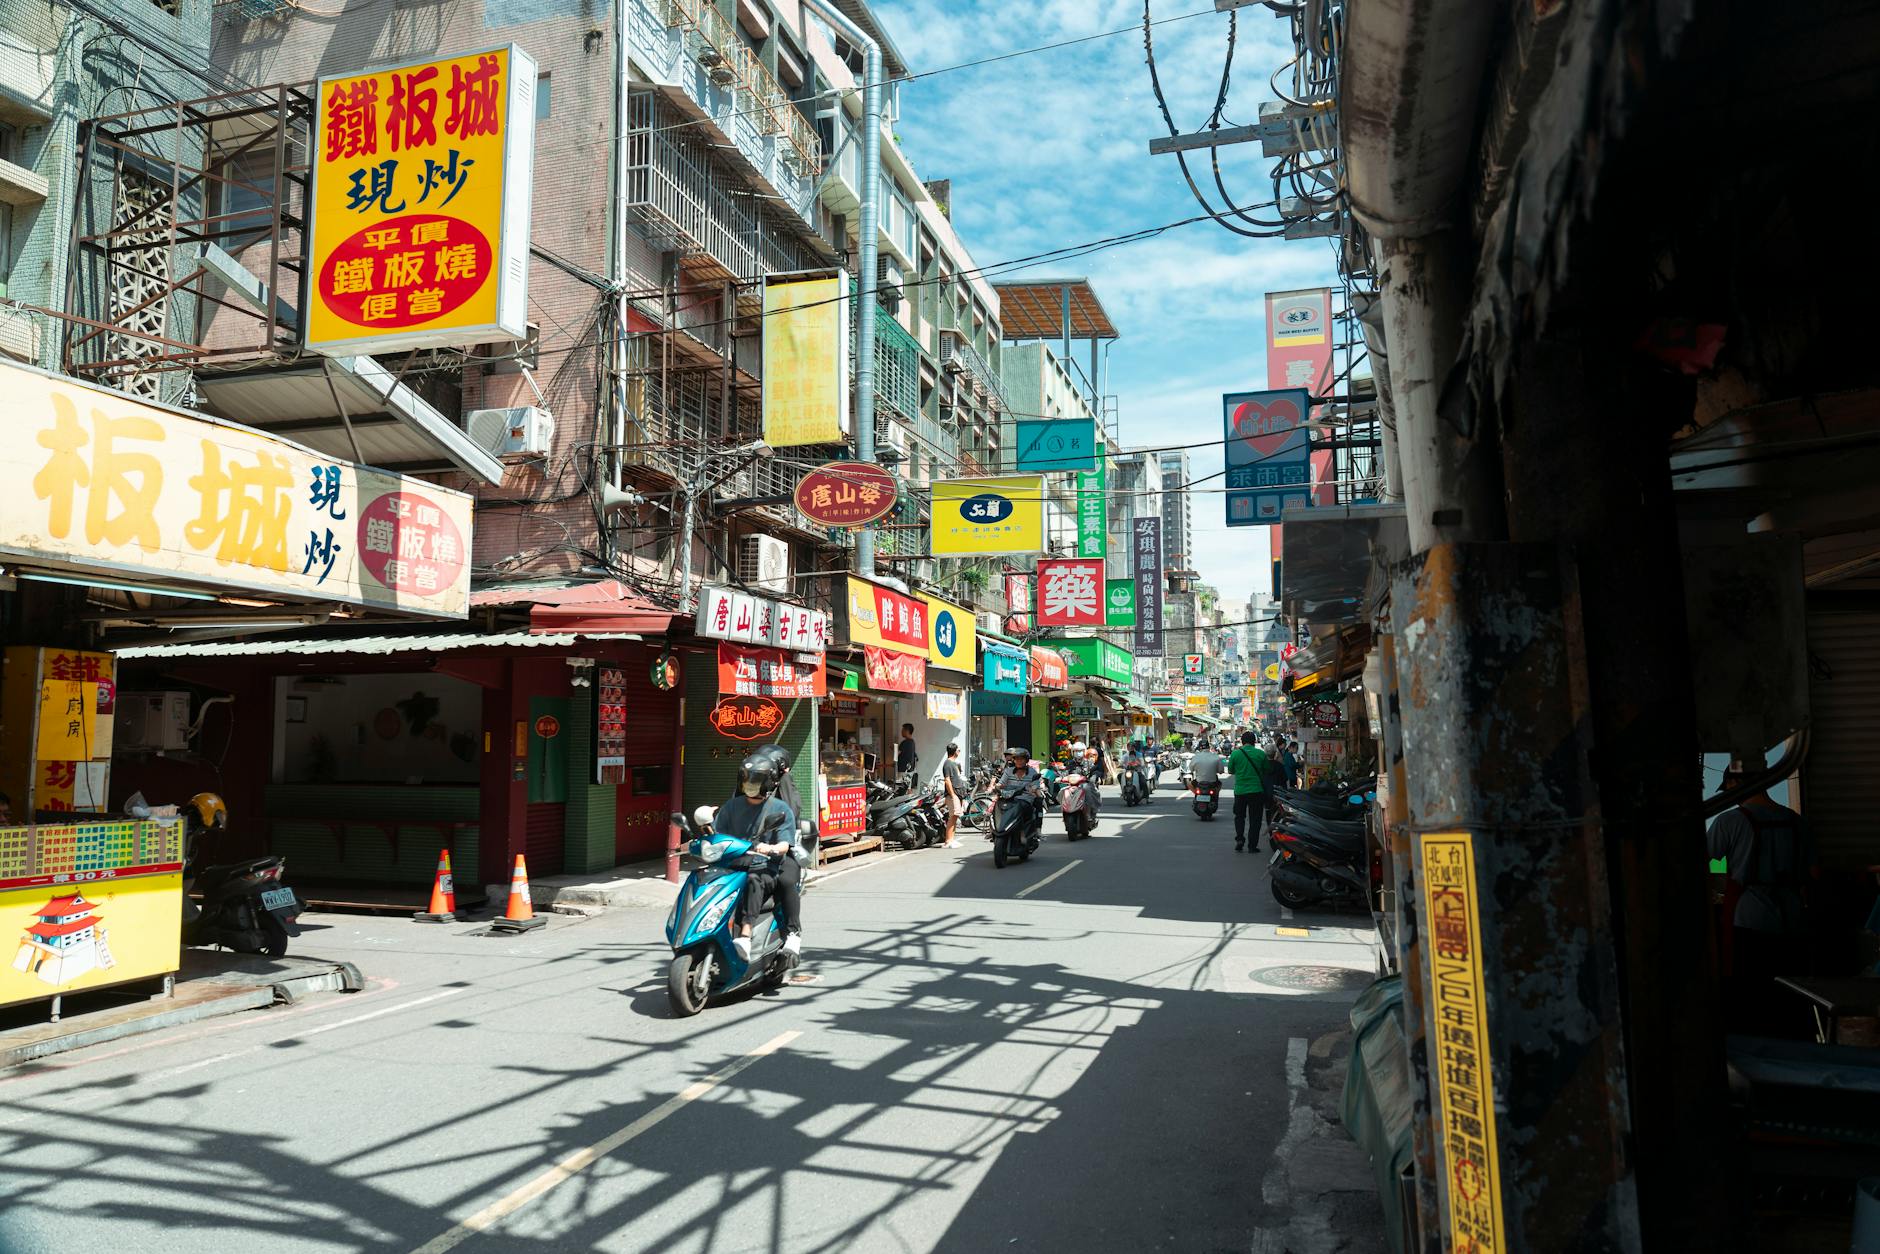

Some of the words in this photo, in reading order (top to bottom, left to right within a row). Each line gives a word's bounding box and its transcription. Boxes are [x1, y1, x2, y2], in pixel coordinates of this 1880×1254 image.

[325, 54, 501, 163] 鐵板城
[345, 149, 476, 214] 現炒
[363, 219, 450, 251] 平價
[331, 243, 478, 297] 鐵板燒
[360, 286, 446, 322] 便當
[33, 392, 295, 577] 板城
[810, 481, 881, 510] 唐山婆
[1229, 465, 1305, 487] 萊爾富
[302, 464, 348, 587] 現炒
[387, 496, 442, 530] 平價
[1082, 477, 1102, 556] 長生素食
[364, 517, 458, 567] 鐵板燒
[382, 557, 439, 591] 便當
[1044, 565, 1098, 618] 藥
[710, 596, 824, 646] 唐山婆古早味
[881, 597, 923, 640] 胖鯨魚
